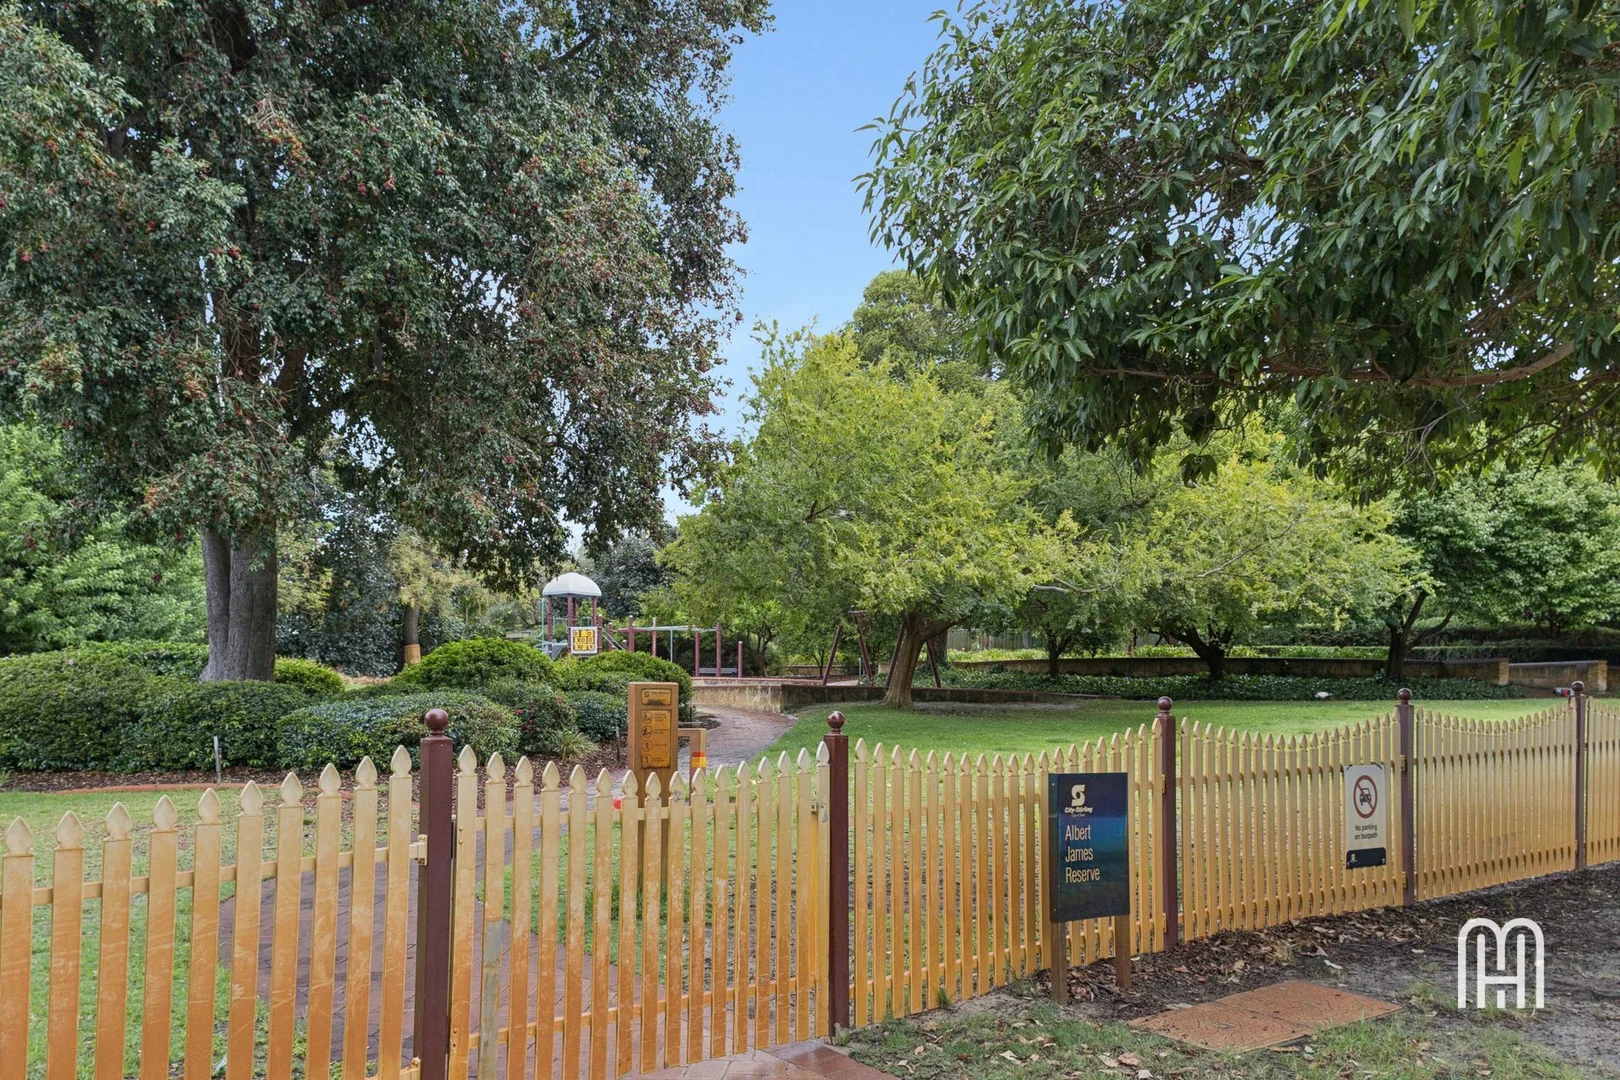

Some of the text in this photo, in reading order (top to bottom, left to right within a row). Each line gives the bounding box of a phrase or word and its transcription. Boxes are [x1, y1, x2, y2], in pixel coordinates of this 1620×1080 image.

[1065, 824, 1091, 841] Albert
[1361, 832, 1378, 840] footpath
[1362, 824, 1378, 832] parking
[1065, 845, 1094, 862] James
[1065, 867, 1101, 883] Reserve
